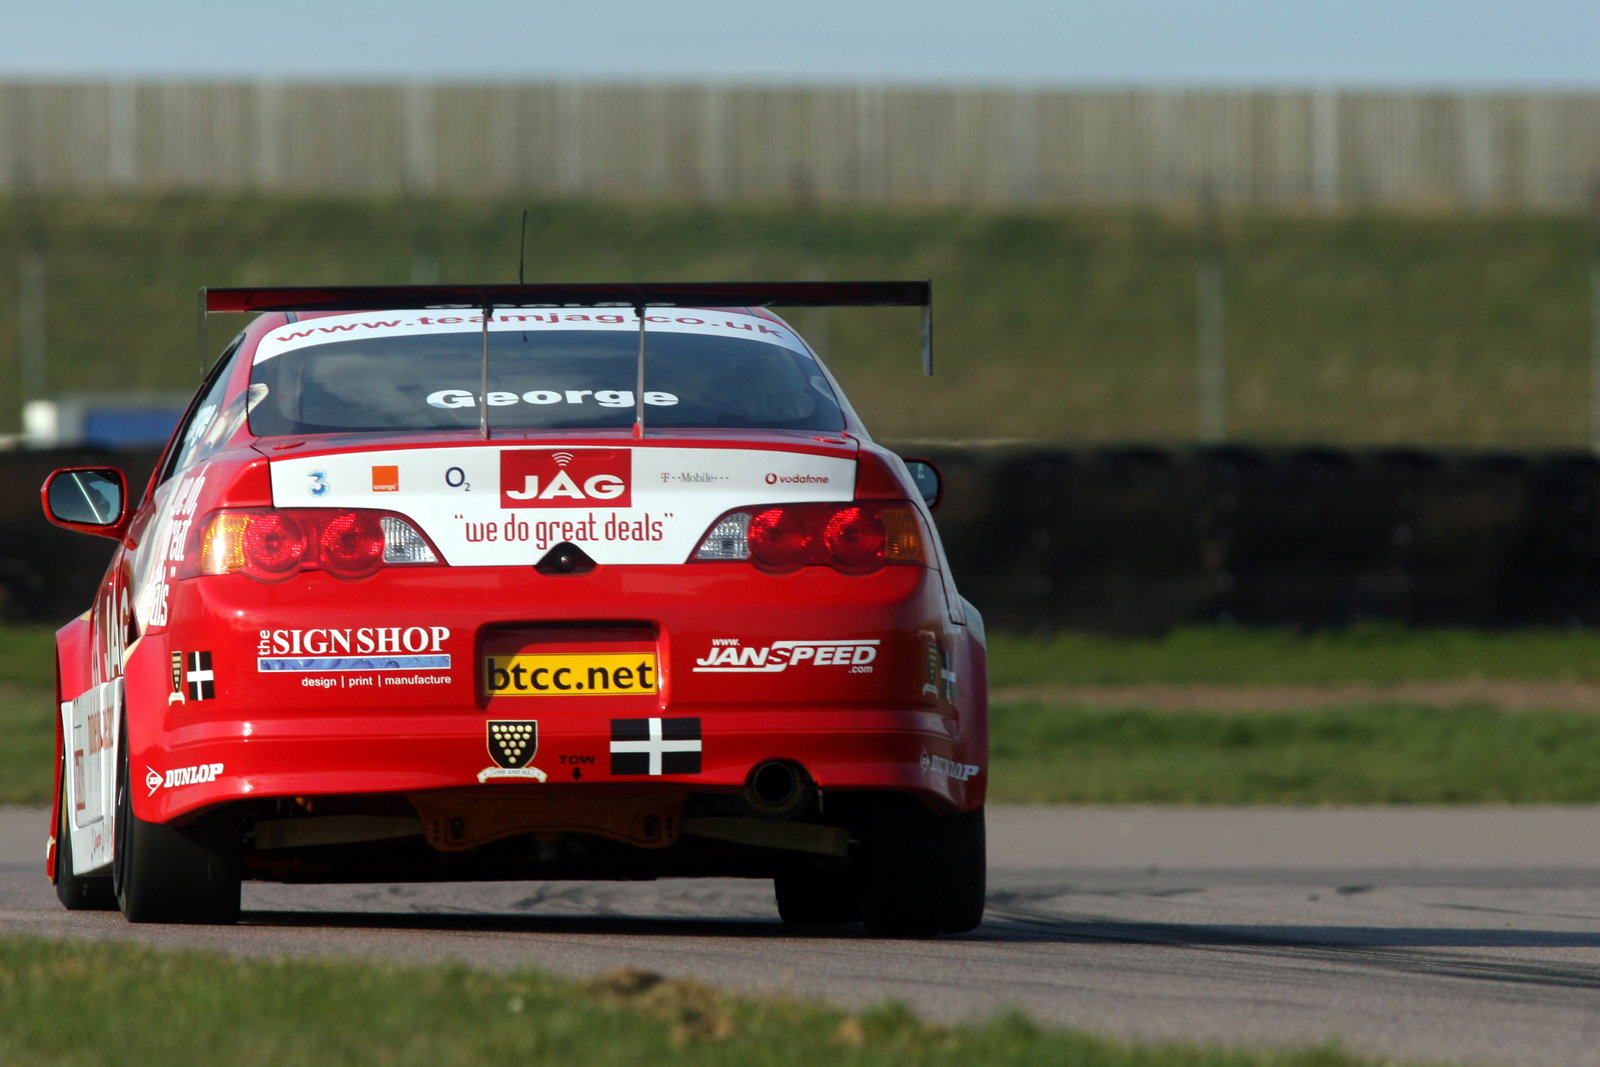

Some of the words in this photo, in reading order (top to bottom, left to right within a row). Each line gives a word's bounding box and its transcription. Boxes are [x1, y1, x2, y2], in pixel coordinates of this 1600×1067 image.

[426, 389, 679, 409] George
[506, 469, 625, 500] JAG
[779, 475, 829, 484] vodafone
[504, 513, 528, 541] do
[535, 513, 598, 550] great
[257, 629, 271, 656] the
[692, 641, 879, 671] JANSPEED
[301, 676, 337, 688] design
[348, 676, 373, 687] print
[384, 675, 451, 685] manufacture
[487, 658, 653, 690] btcc.net
[848, 665, 873, 673] .com
[560, 755, 595, 765] TOW
[163, 763, 224, 788] DUNLOP
